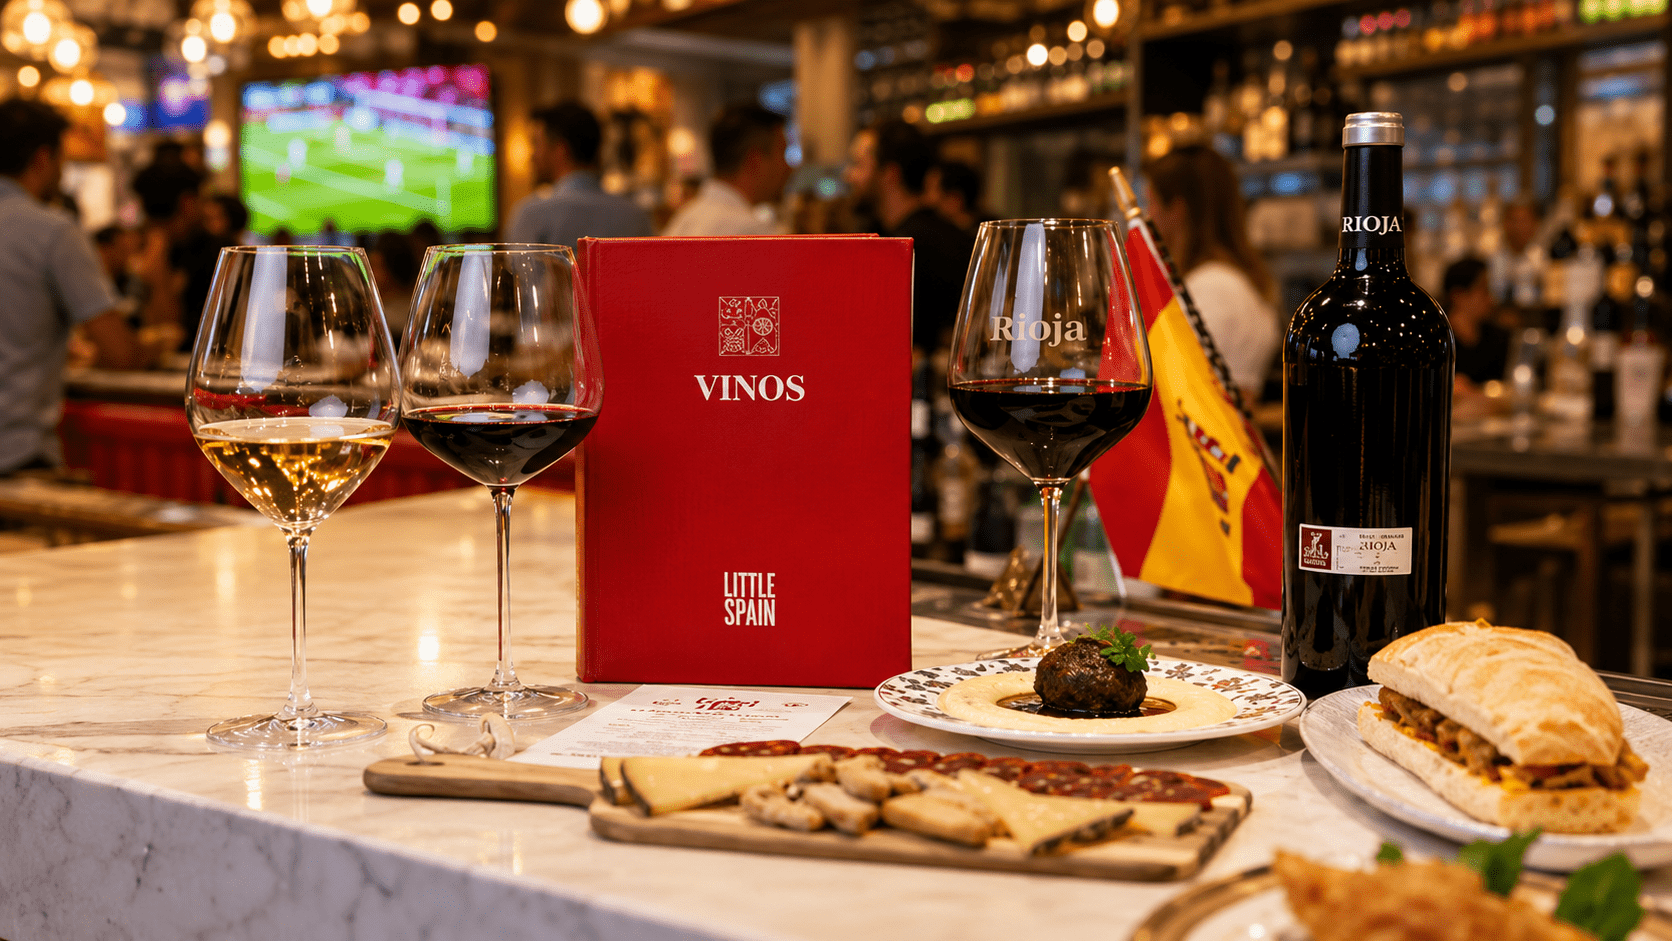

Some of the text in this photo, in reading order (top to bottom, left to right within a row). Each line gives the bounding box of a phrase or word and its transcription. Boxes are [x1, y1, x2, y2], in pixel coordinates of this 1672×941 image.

[1341, 215, 1403, 236] RIOJA
[989, 312, 1087, 347] Rioja
[693, 374, 806, 402] VINOS
[723, 571, 776, 598] LITTLE
[723, 598, 776, 627] SPAIN
